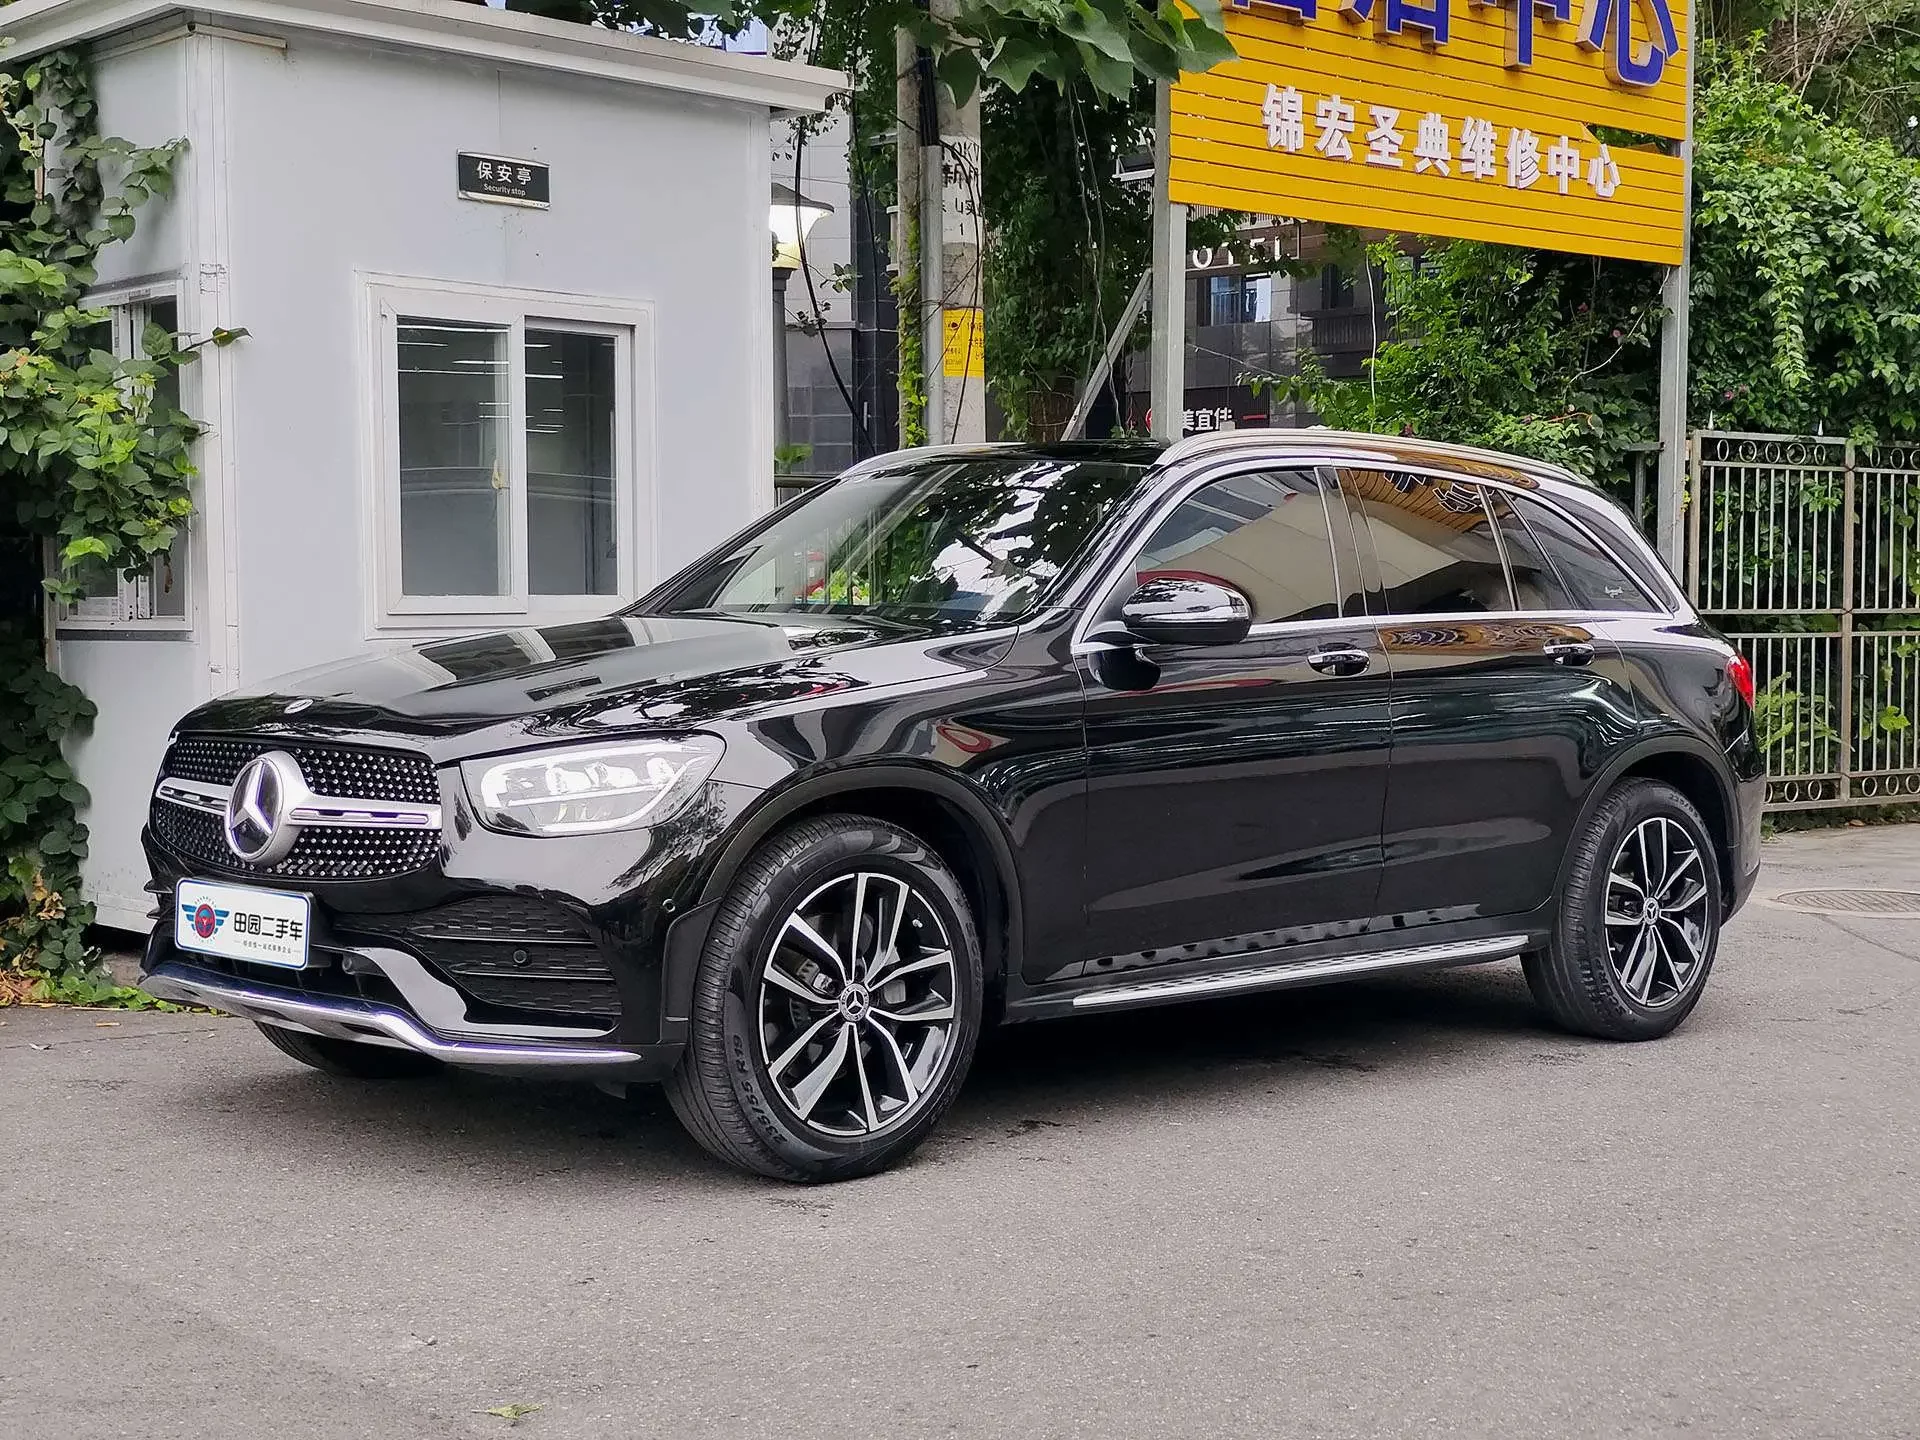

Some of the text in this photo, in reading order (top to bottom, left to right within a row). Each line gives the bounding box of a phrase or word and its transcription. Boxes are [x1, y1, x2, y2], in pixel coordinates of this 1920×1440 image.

[1261, 82, 1621, 198] 锦宏圣典维修中心
[476, 160, 532, 185] 保安亭
[483, 183, 526, 196] Security stop
[233, 911, 303, 942] 田园二手车
[740, 1079, 788, 1143] 235/55
